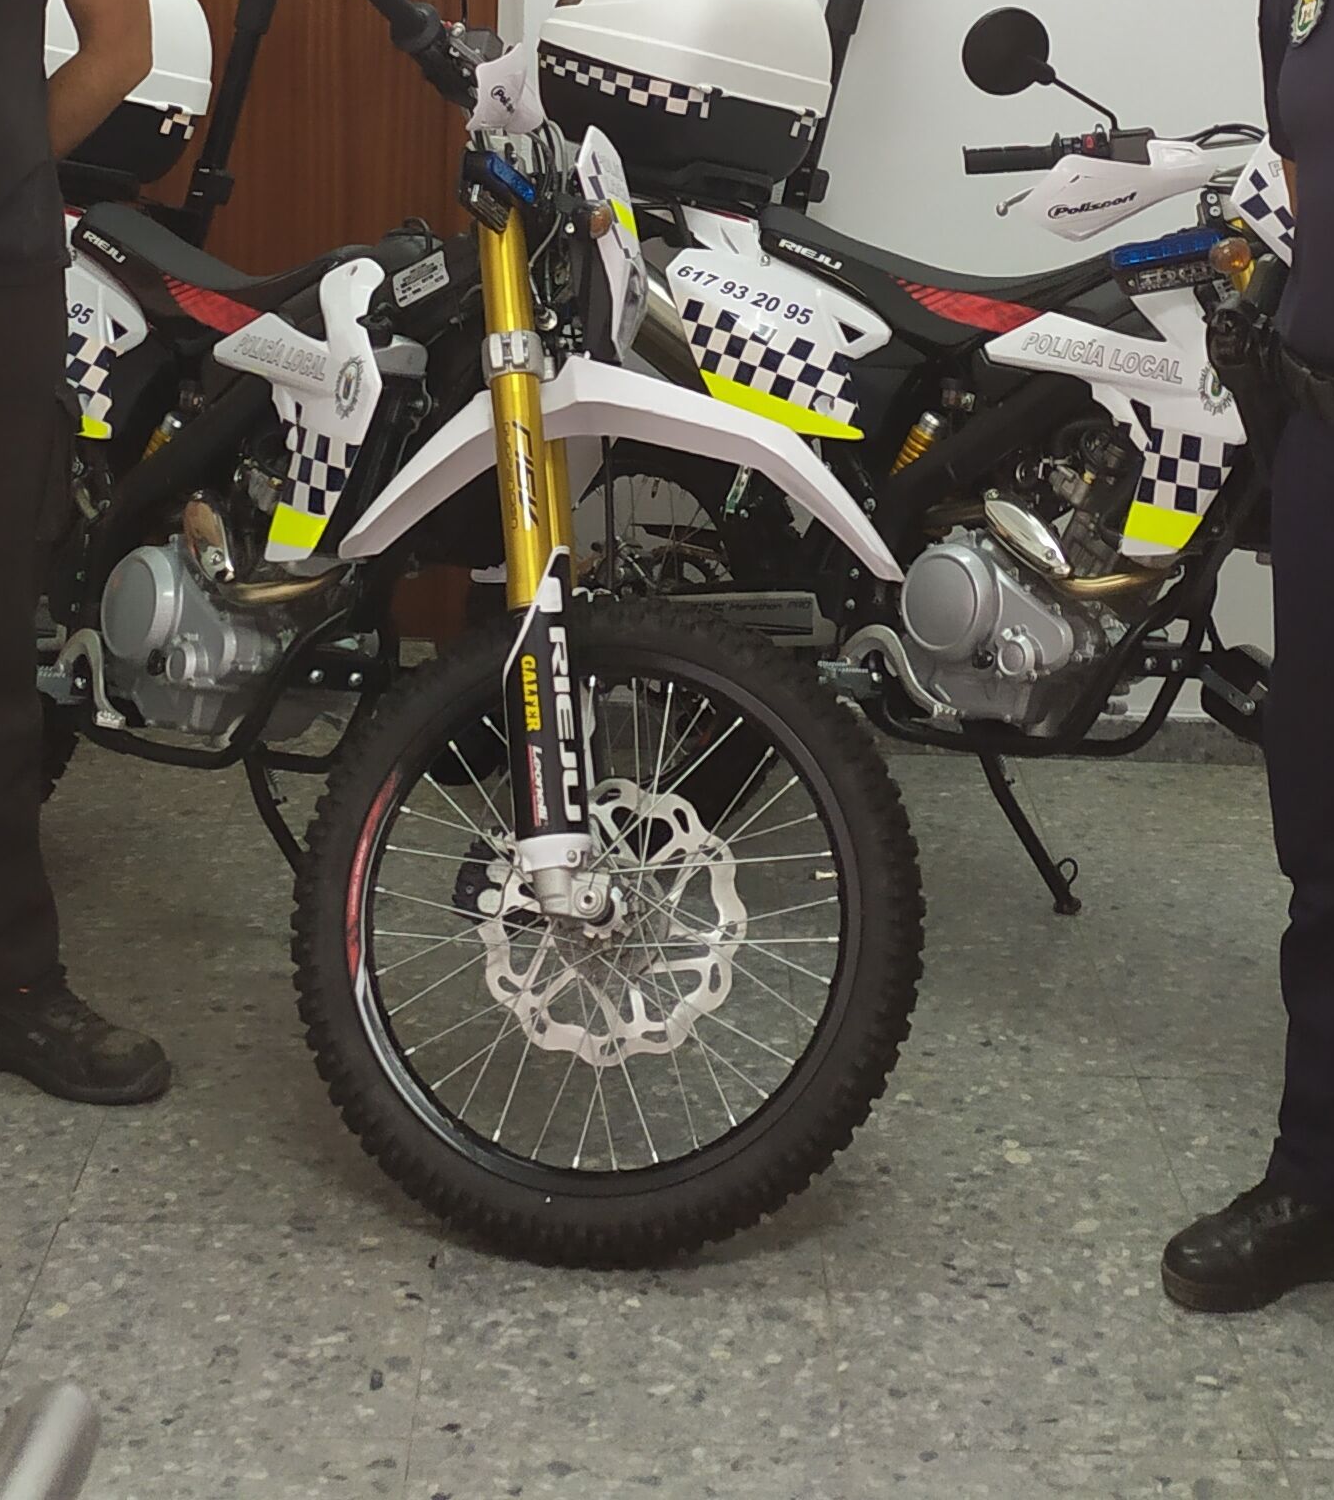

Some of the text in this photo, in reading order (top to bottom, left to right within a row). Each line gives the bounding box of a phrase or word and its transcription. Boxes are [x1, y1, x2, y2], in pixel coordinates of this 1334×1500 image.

[1047, 191, 1137, 219] Polisport
[82, 230, 126, 263] RIEJU
[778, 238, 843, 270] RIEJU
[677, 266, 814, 325] 617 93 20 95
[233, 334, 327, 381] POLICÍA LOCAL
[1021, 331, 1183, 385] POLICÍA LOCAL
[521, 654, 541, 731] GALFER
[549, 627, 581, 821] RIEJU
